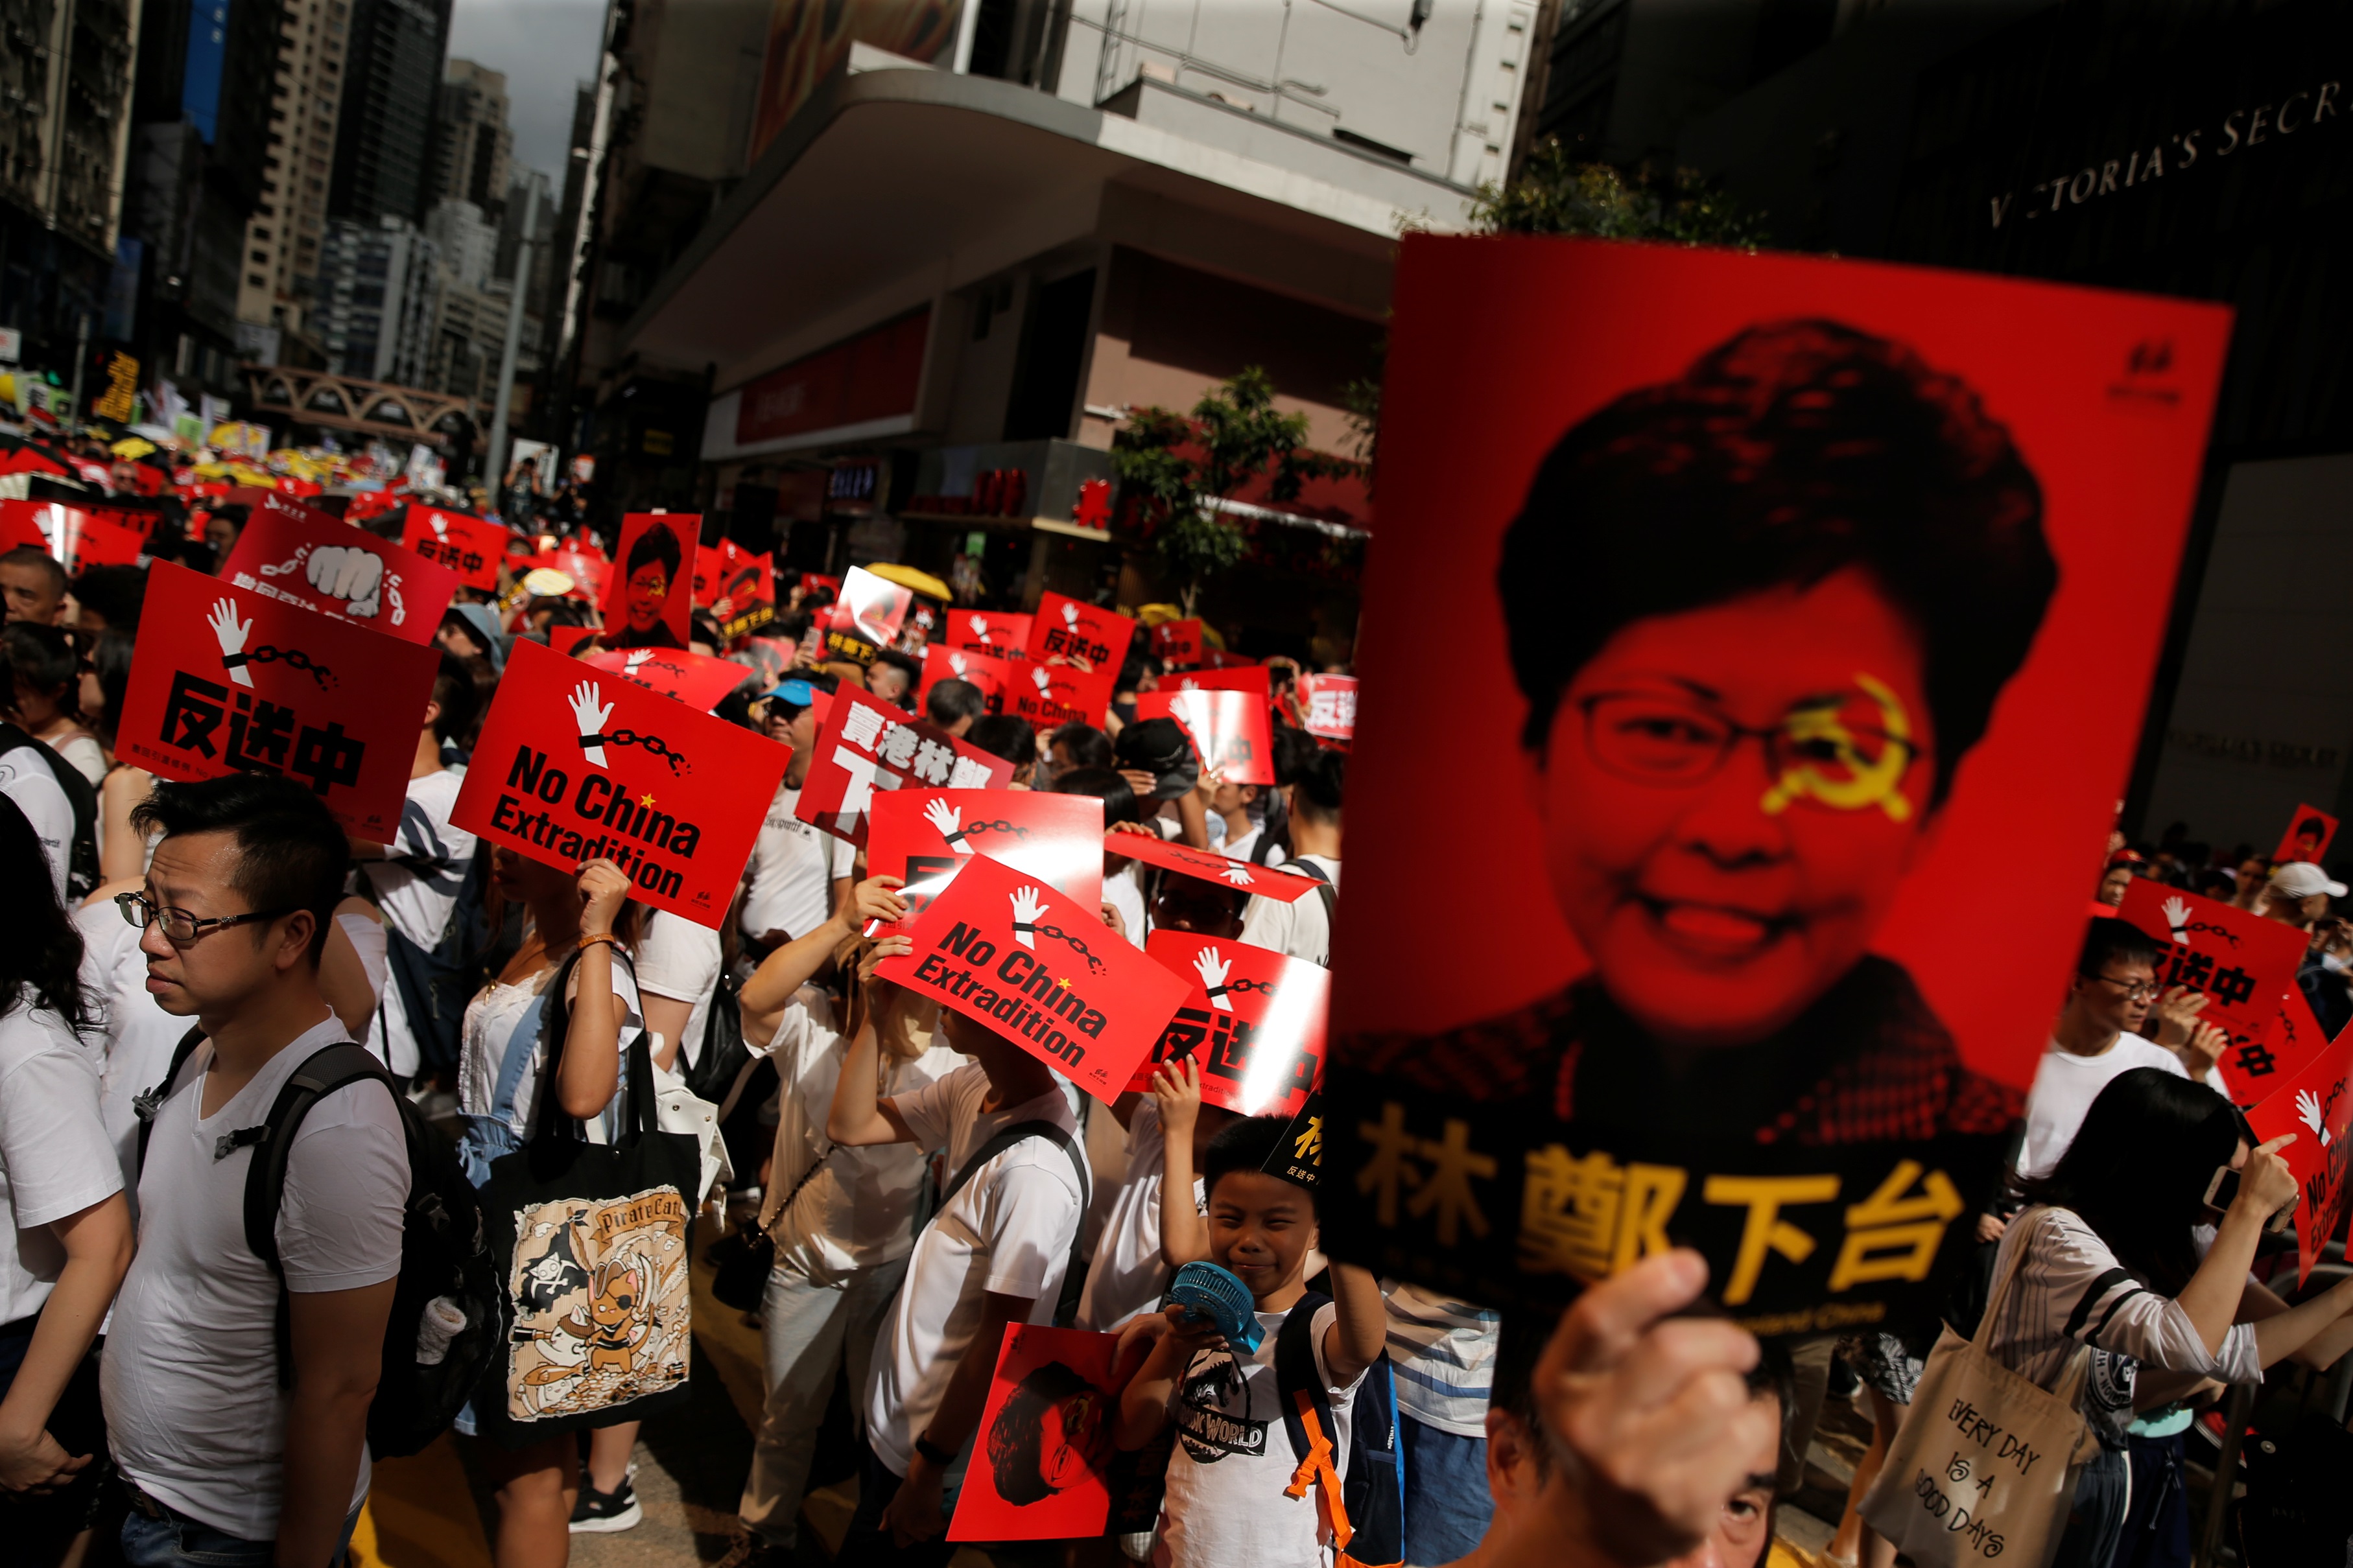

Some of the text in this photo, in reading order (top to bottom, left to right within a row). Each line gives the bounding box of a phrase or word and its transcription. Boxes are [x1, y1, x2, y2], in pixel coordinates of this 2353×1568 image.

[1991, 80, 2353, 229] VTORIA'S SECR
[1044, 627, 1110, 665] 反送中
[160, 669, 366, 797] 反送中
[1017, 696, 1087, 724] No China
[490, 793, 683, 899] Extradition
[506, 744, 701, 860] No China
[913, 953, 1085, 1068] Extradition
[937, 921, 1107, 1040] No China
[1286, 1165, 1316, 1182] 反送中
[1358, 1101, 1965, 1306] 林鄭下台
[1207, 1414, 1263, 1448] WORLD
[1946, 1451, 1995, 1500] IS A
[1948, 1398, 2040, 1476] EVERY DAY
[1948, 1507, 2004, 1558] DAYS
